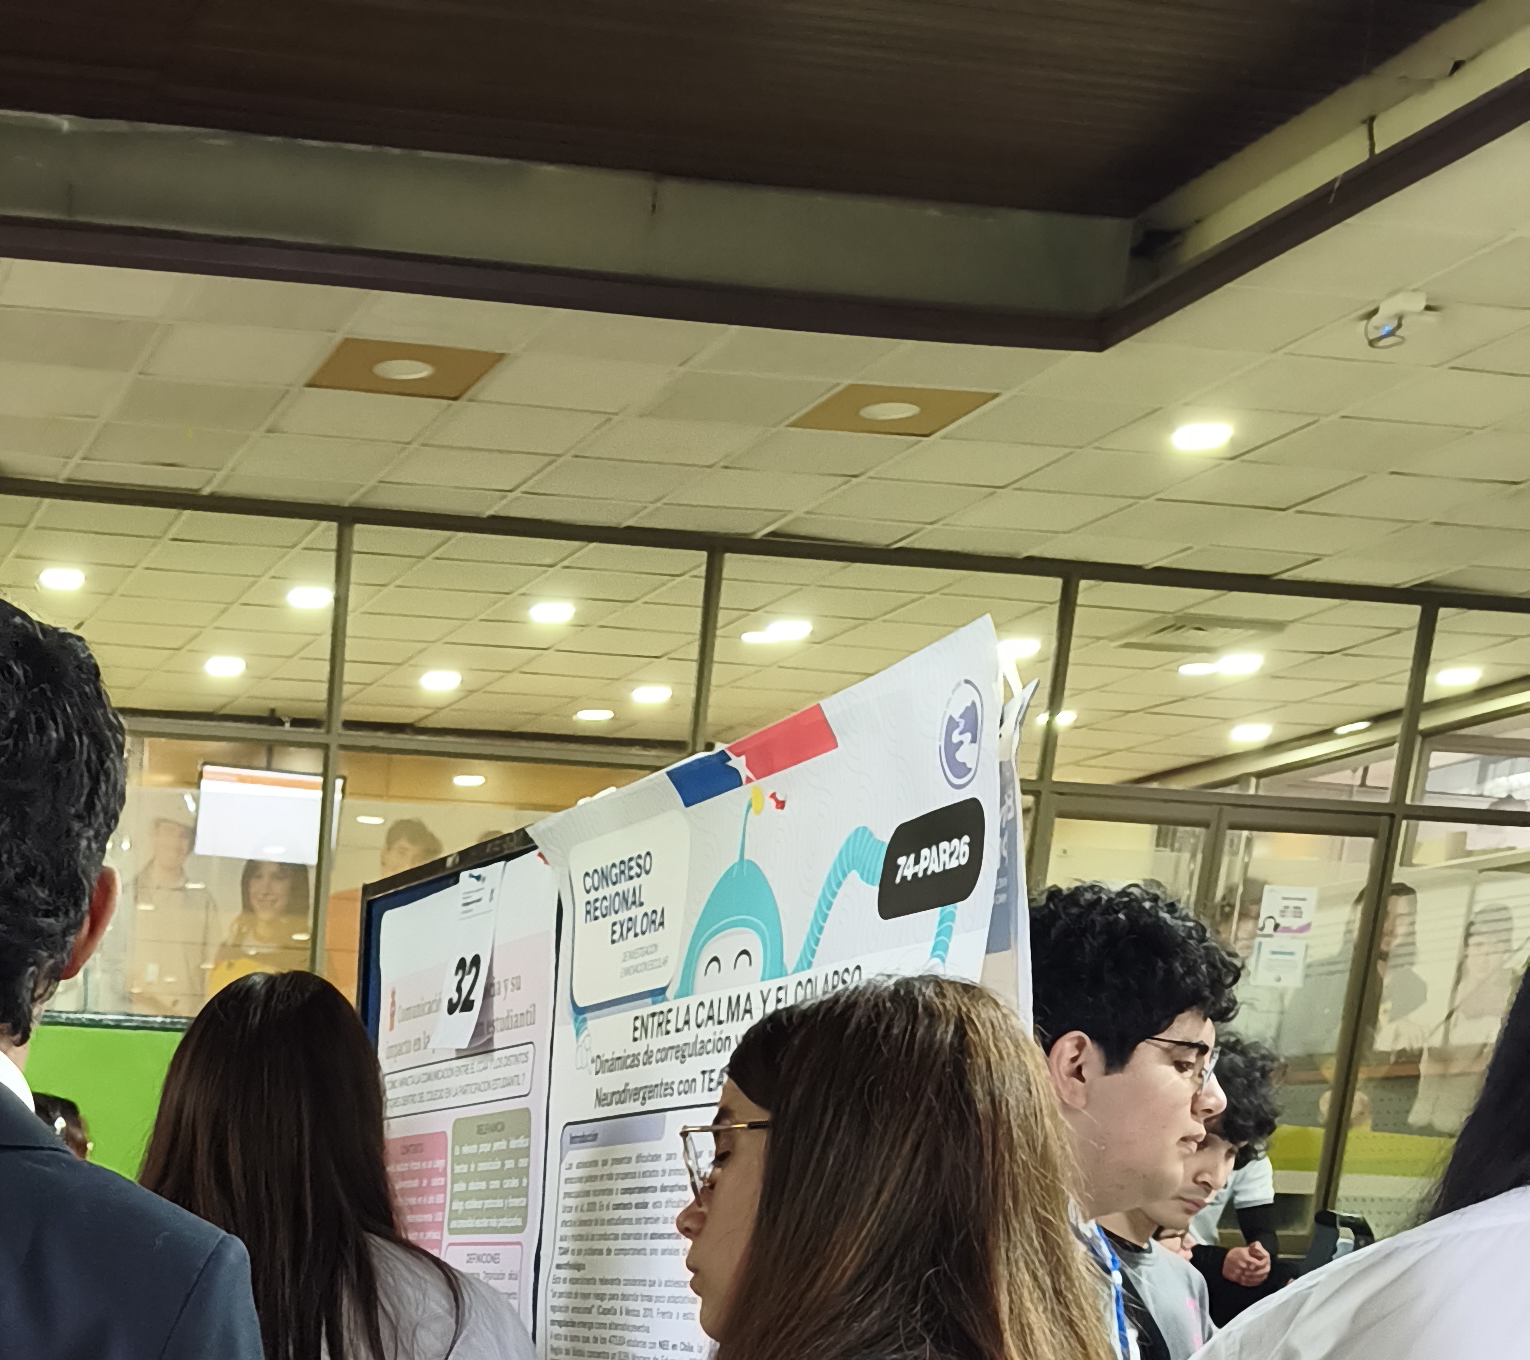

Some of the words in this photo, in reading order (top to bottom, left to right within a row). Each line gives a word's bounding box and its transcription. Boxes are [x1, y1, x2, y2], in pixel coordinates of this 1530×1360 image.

[583, 851, 653, 894] CONGRESO
[895, 835, 970, 884] 74-PAR26
[585, 884, 645, 924] REGIONAL
[610, 906, 665, 945] EXPLORA
[447, 953, 482, 1016] 32
[511, 975, 521, 992] su
[632, 1013, 673, 1043] ENTRE
[674, 1005, 691, 1033] LA
[694, 992, 754, 1030] CALMA
[760, 987, 773, 1013] Y
[642, 1043, 653, 1067] de
[655, 1031, 732, 1065] corregulación
[594, 1080, 675, 1110] Neurodivergentes
[677, 1077, 697, 1096] con
